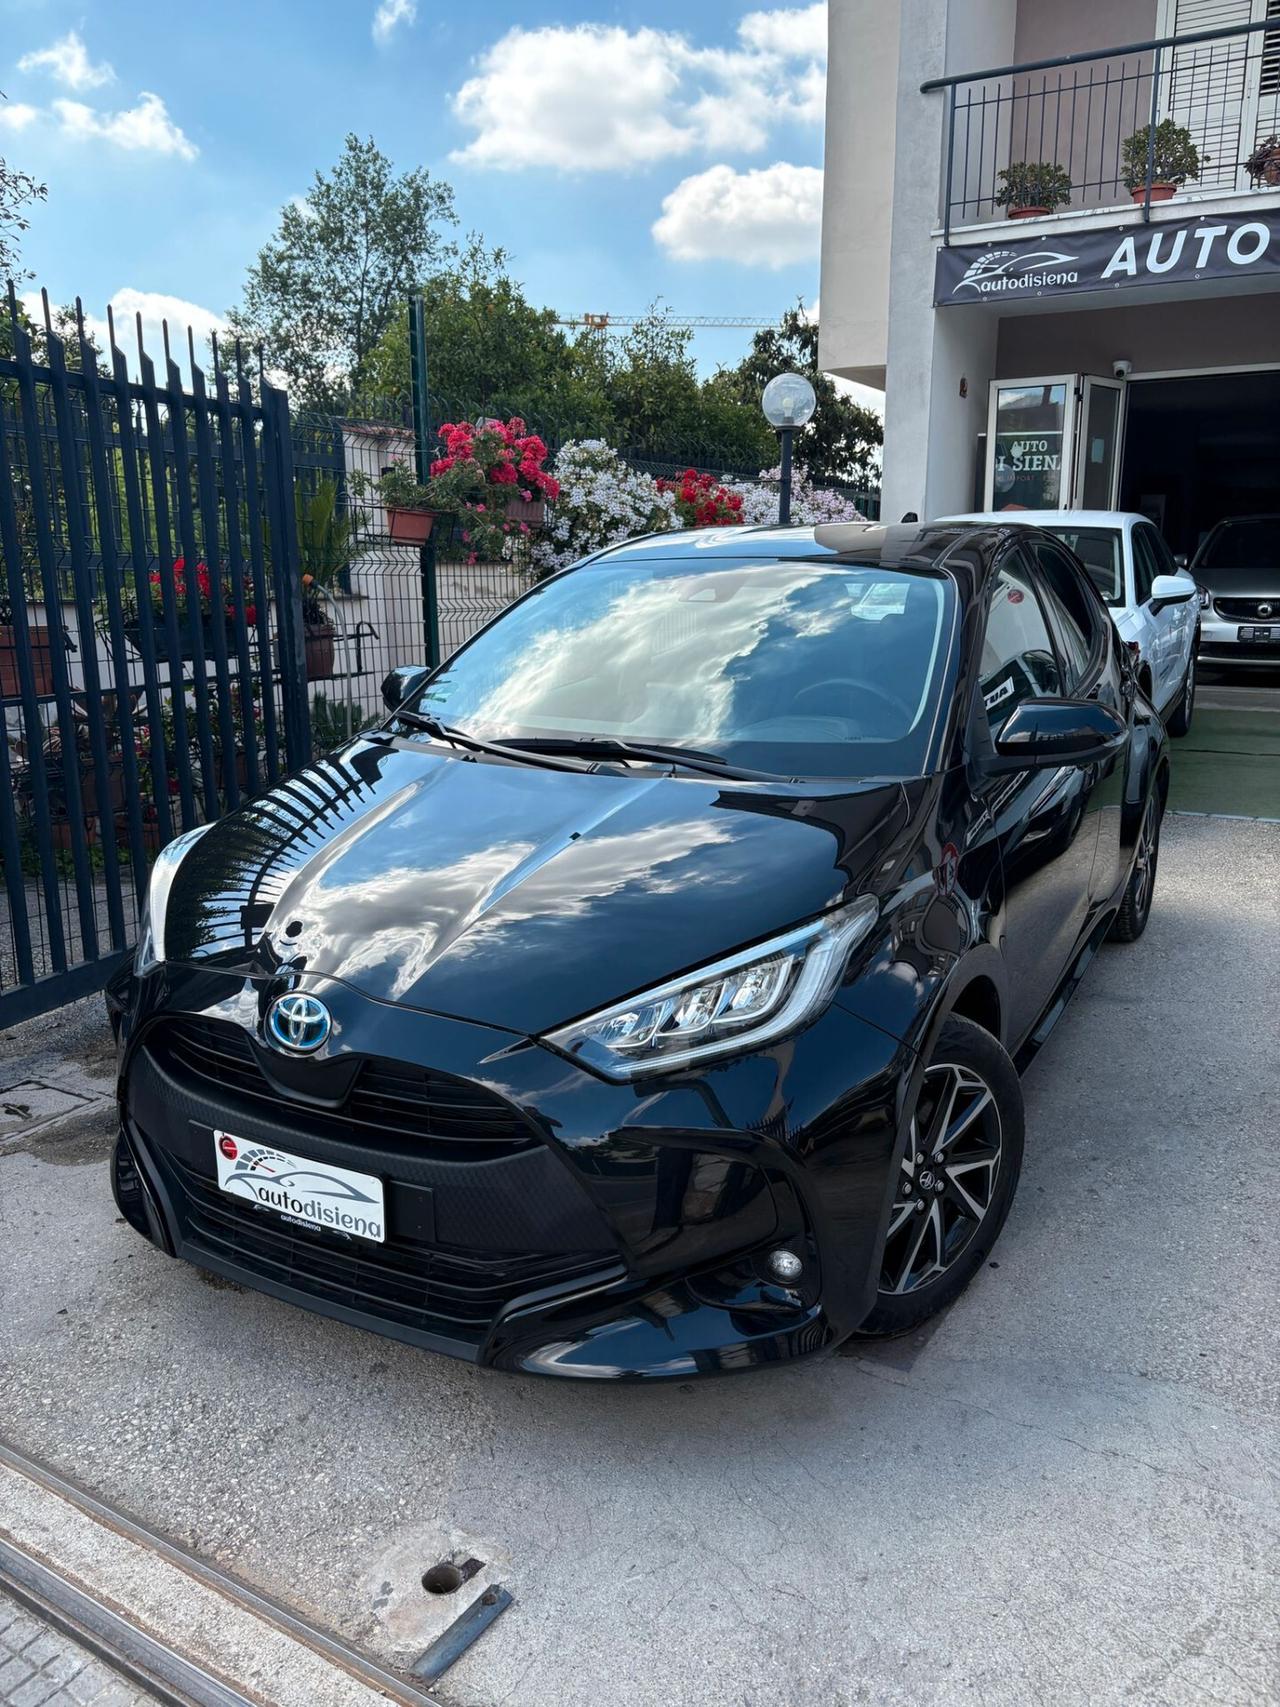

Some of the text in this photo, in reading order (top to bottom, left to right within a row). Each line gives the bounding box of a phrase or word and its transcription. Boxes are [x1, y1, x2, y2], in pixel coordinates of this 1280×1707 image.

[980, 222, 1271, 293] autodisiena AUTO
[995, 455, 1006, 471] I
[258, 1187, 381, 1238] autodisiena
[280, 1214, 321, 1232] autodisiena
